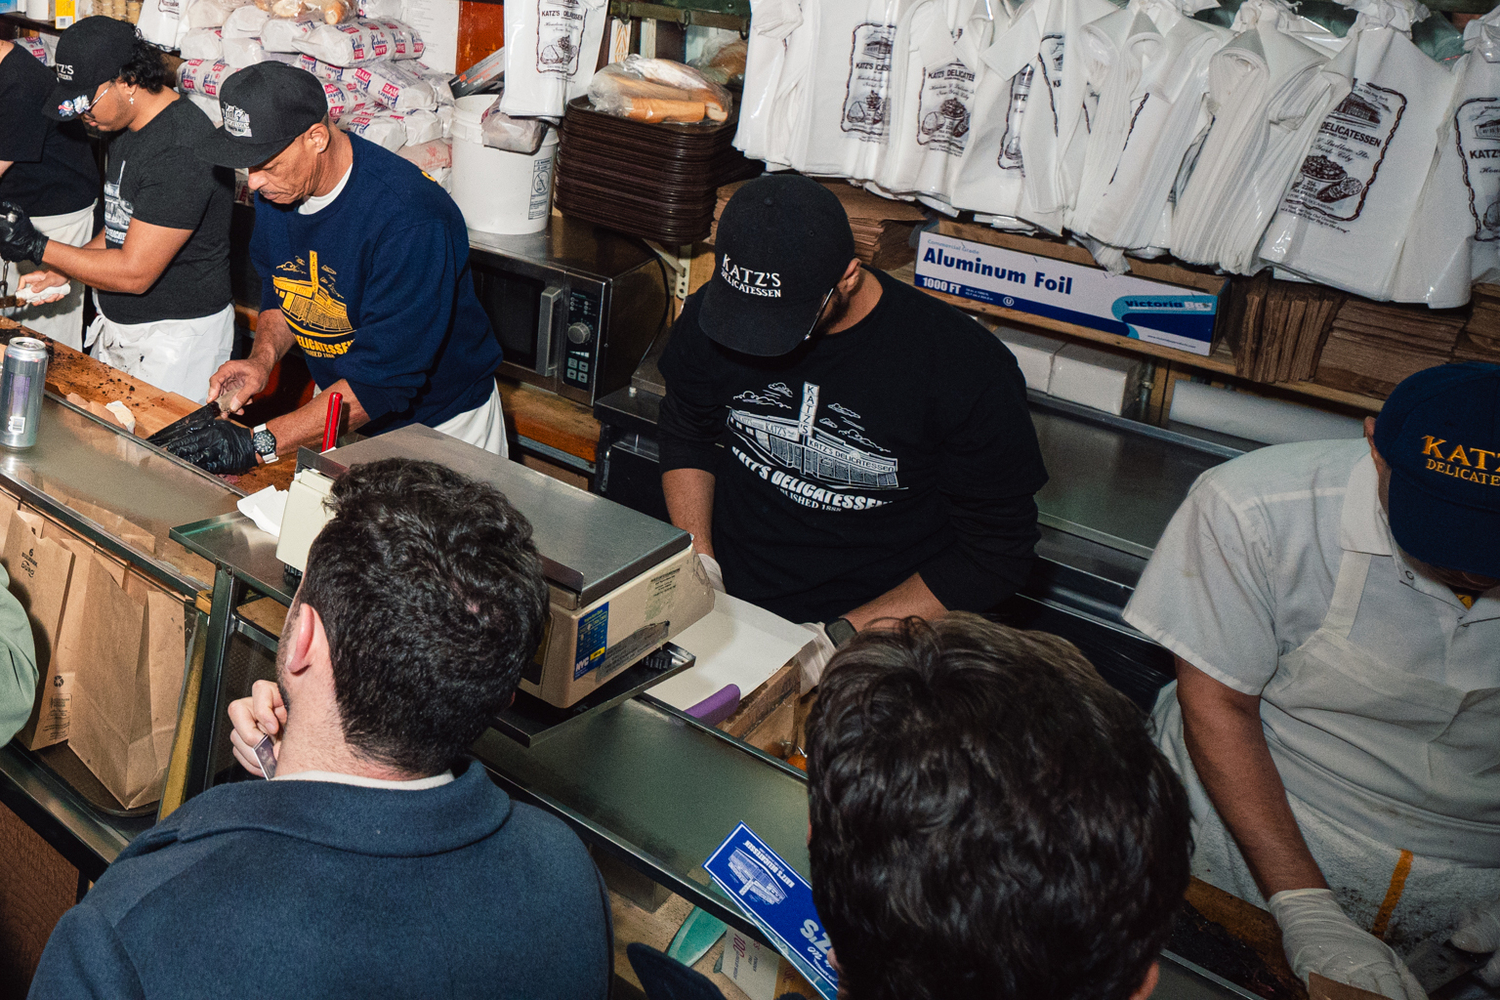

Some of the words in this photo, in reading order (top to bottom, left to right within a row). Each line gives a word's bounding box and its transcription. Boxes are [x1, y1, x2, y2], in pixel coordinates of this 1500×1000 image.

[946, 68, 976, 82] DELICATES
[1320, 121, 1382, 148] DELICATESSEN
[1469, 149, 1500, 160] KATZ
[721, 267, 782, 298] DELICATESSEN
[722, 253, 782, 287] KATZ'S
[923, 247, 1027, 285] Aluminum
[1034, 271, 1073, 295] Foil
[922, 276, 949, 293] 1000
[949, 283, 962, 295] FT
[1124, 299, 1184, 310] Victoria
[296, 334, 354, 355] ELICATESSE
[765, 422, 787, 437] KATZ'S
[809, 440, 834, 455] KATZ'S
[835, 450, 895, 472] DELICATESSEN
[1421, 434, 1500, 472] KAT
[1425, 458, 1500, 487] DELICATE
[771, 471, 893, 511] DELICATESSE
[575, 656, 590, 672] NYC
